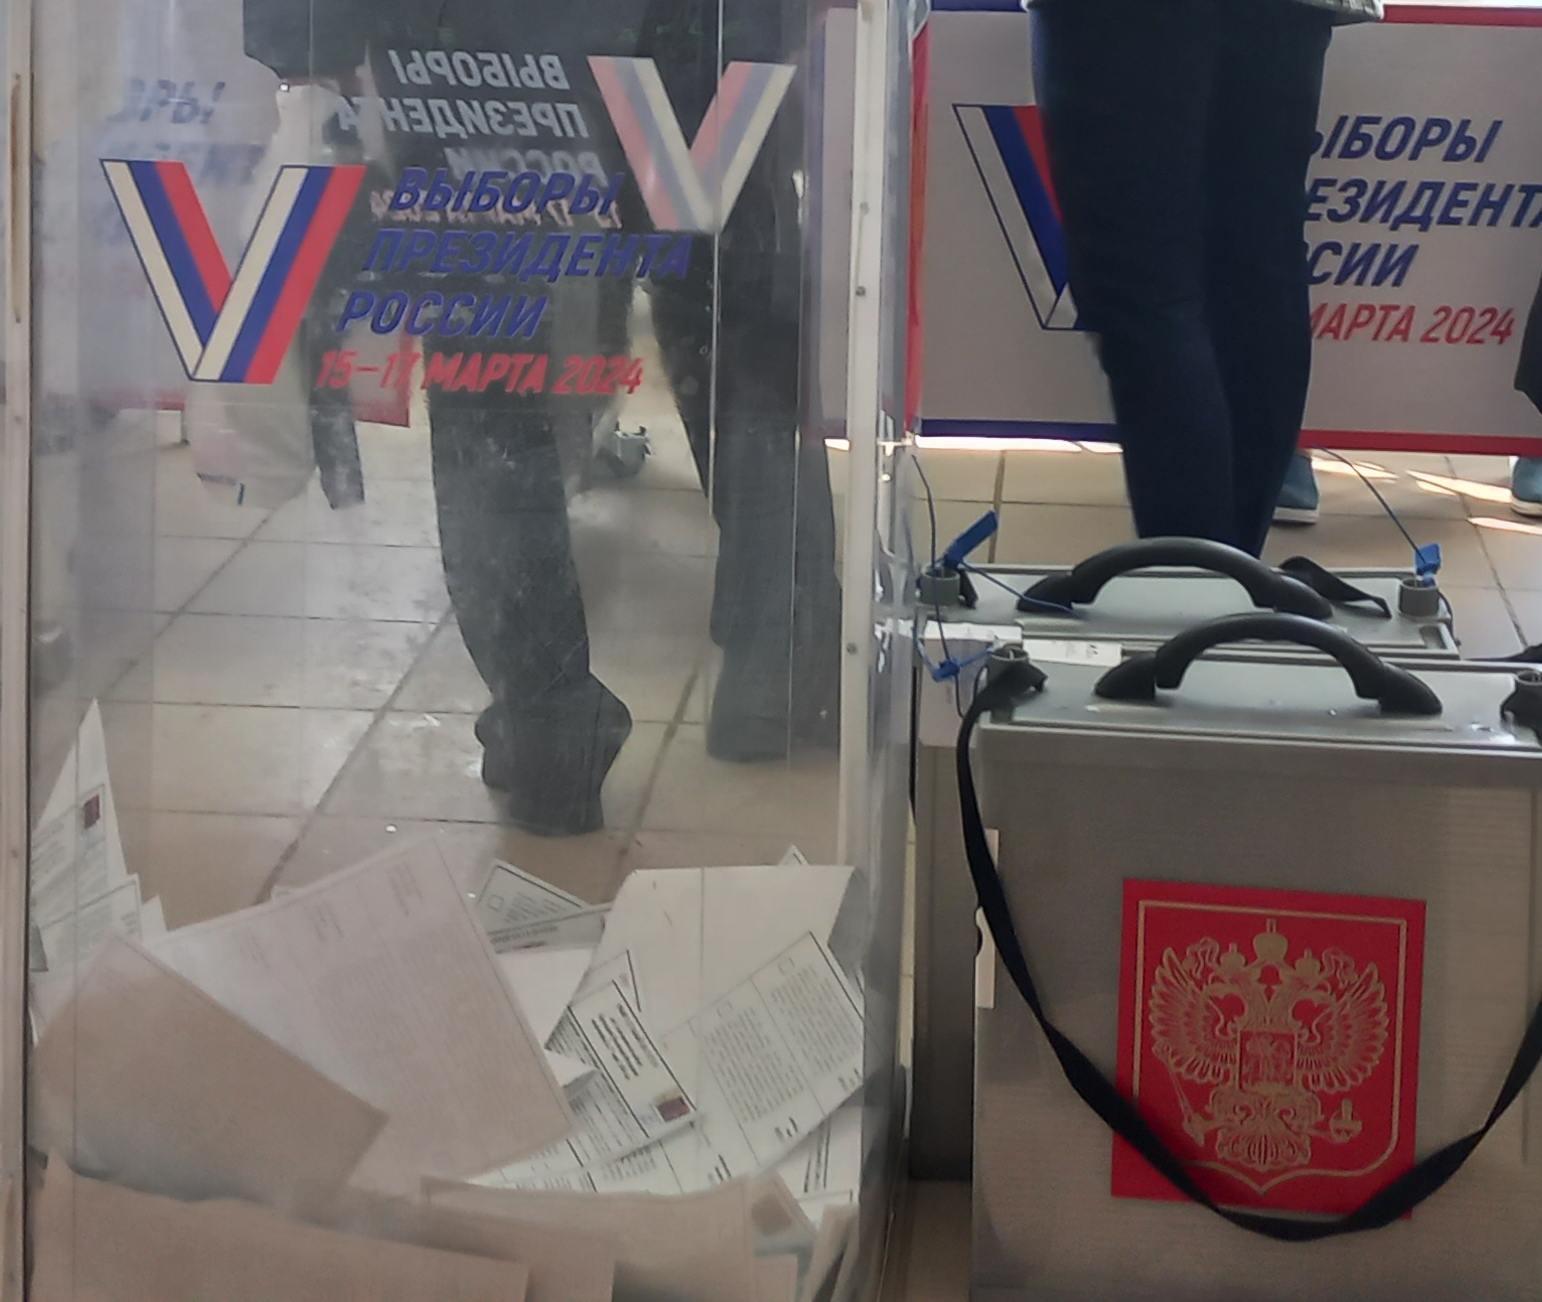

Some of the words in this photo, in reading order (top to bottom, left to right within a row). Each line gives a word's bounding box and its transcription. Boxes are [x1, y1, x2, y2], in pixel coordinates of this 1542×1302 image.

[1314, 114, 1504, 164] ЫБОРЫ
[389, 166, 625, 216] ВЫБОРЫ
[361, 227, 692, 283] ПРЕЗИДЕНТА
[1308, 240, 1420, 288] СИИ
[335, 291, 549, 339] РОССИИ
[1419, 304, 1516, 346] 2024
[421, 351, 549, 394] МАРТА
[551, 355, 645, 396] 2024
